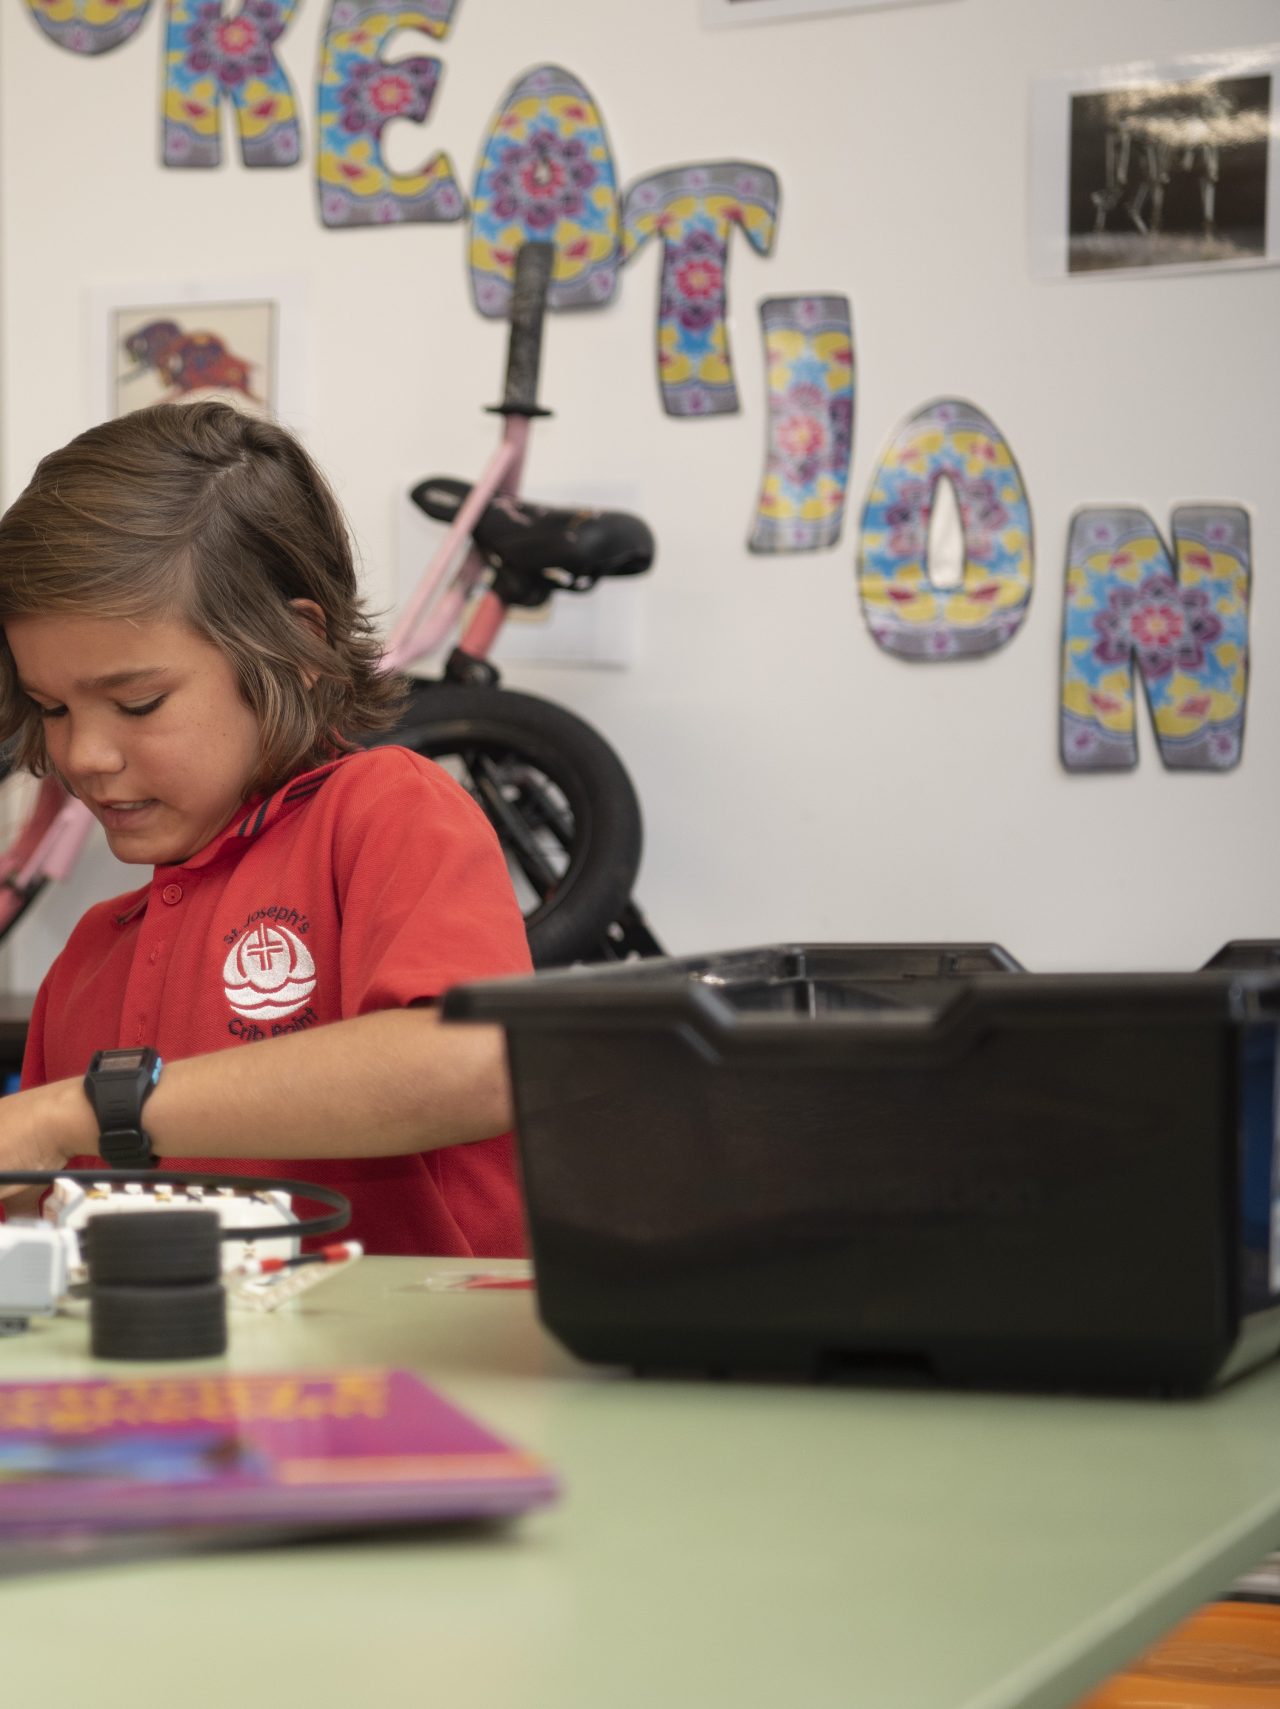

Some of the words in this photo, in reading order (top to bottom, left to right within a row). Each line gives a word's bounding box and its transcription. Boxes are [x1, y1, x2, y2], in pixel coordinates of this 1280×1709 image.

[23, 0, 1252, 773] REATION
[243, 906, 310, 935] Joseph's
[228, 1018, 267, 1041] Crib
